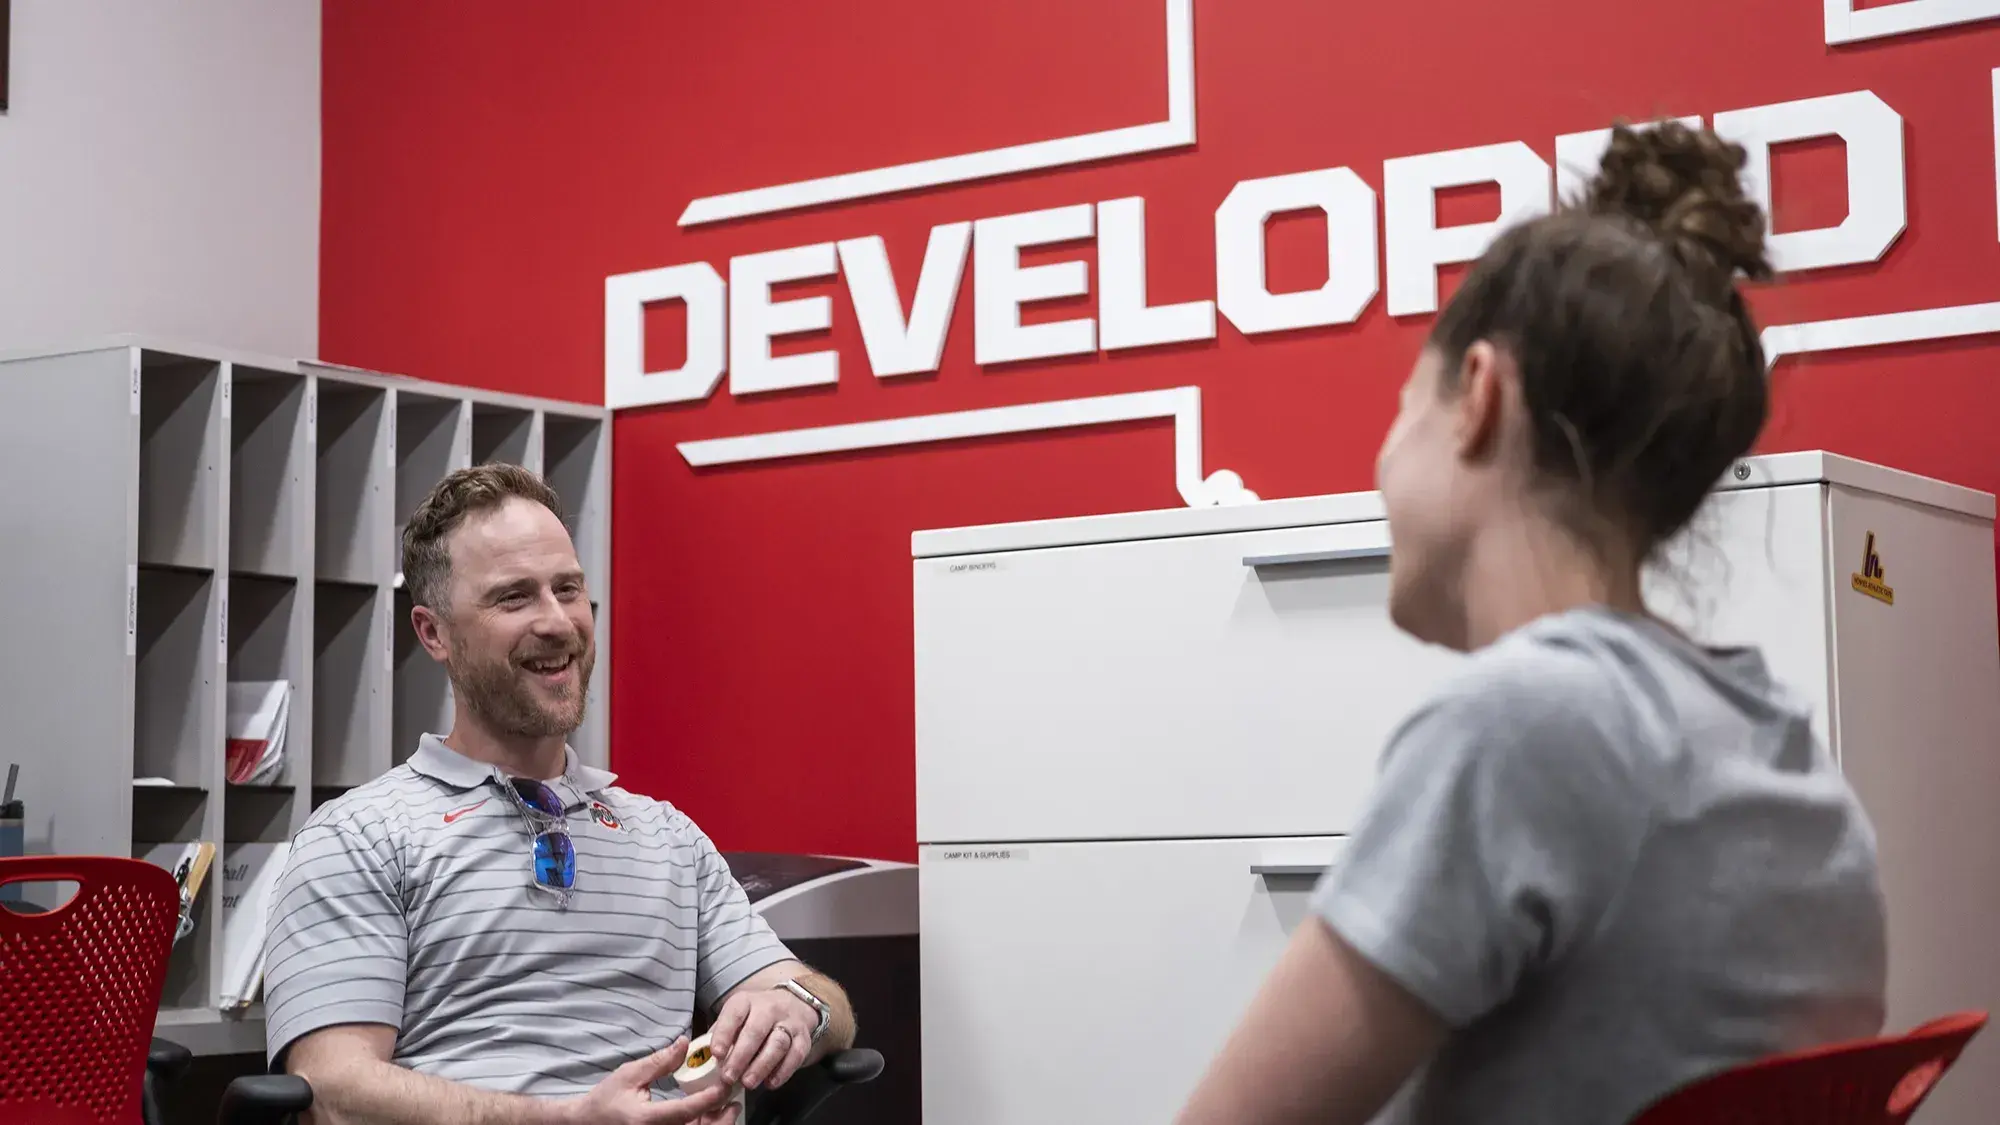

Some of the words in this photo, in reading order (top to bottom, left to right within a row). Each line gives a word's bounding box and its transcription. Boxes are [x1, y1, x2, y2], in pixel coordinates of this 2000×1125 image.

[950, 564, 967, 573] CAMP
[944, 852, 961, 860] CAMP
[963, 851, 972, 859] KIT
[980, 850, 1011, 859] SUPPLIES
